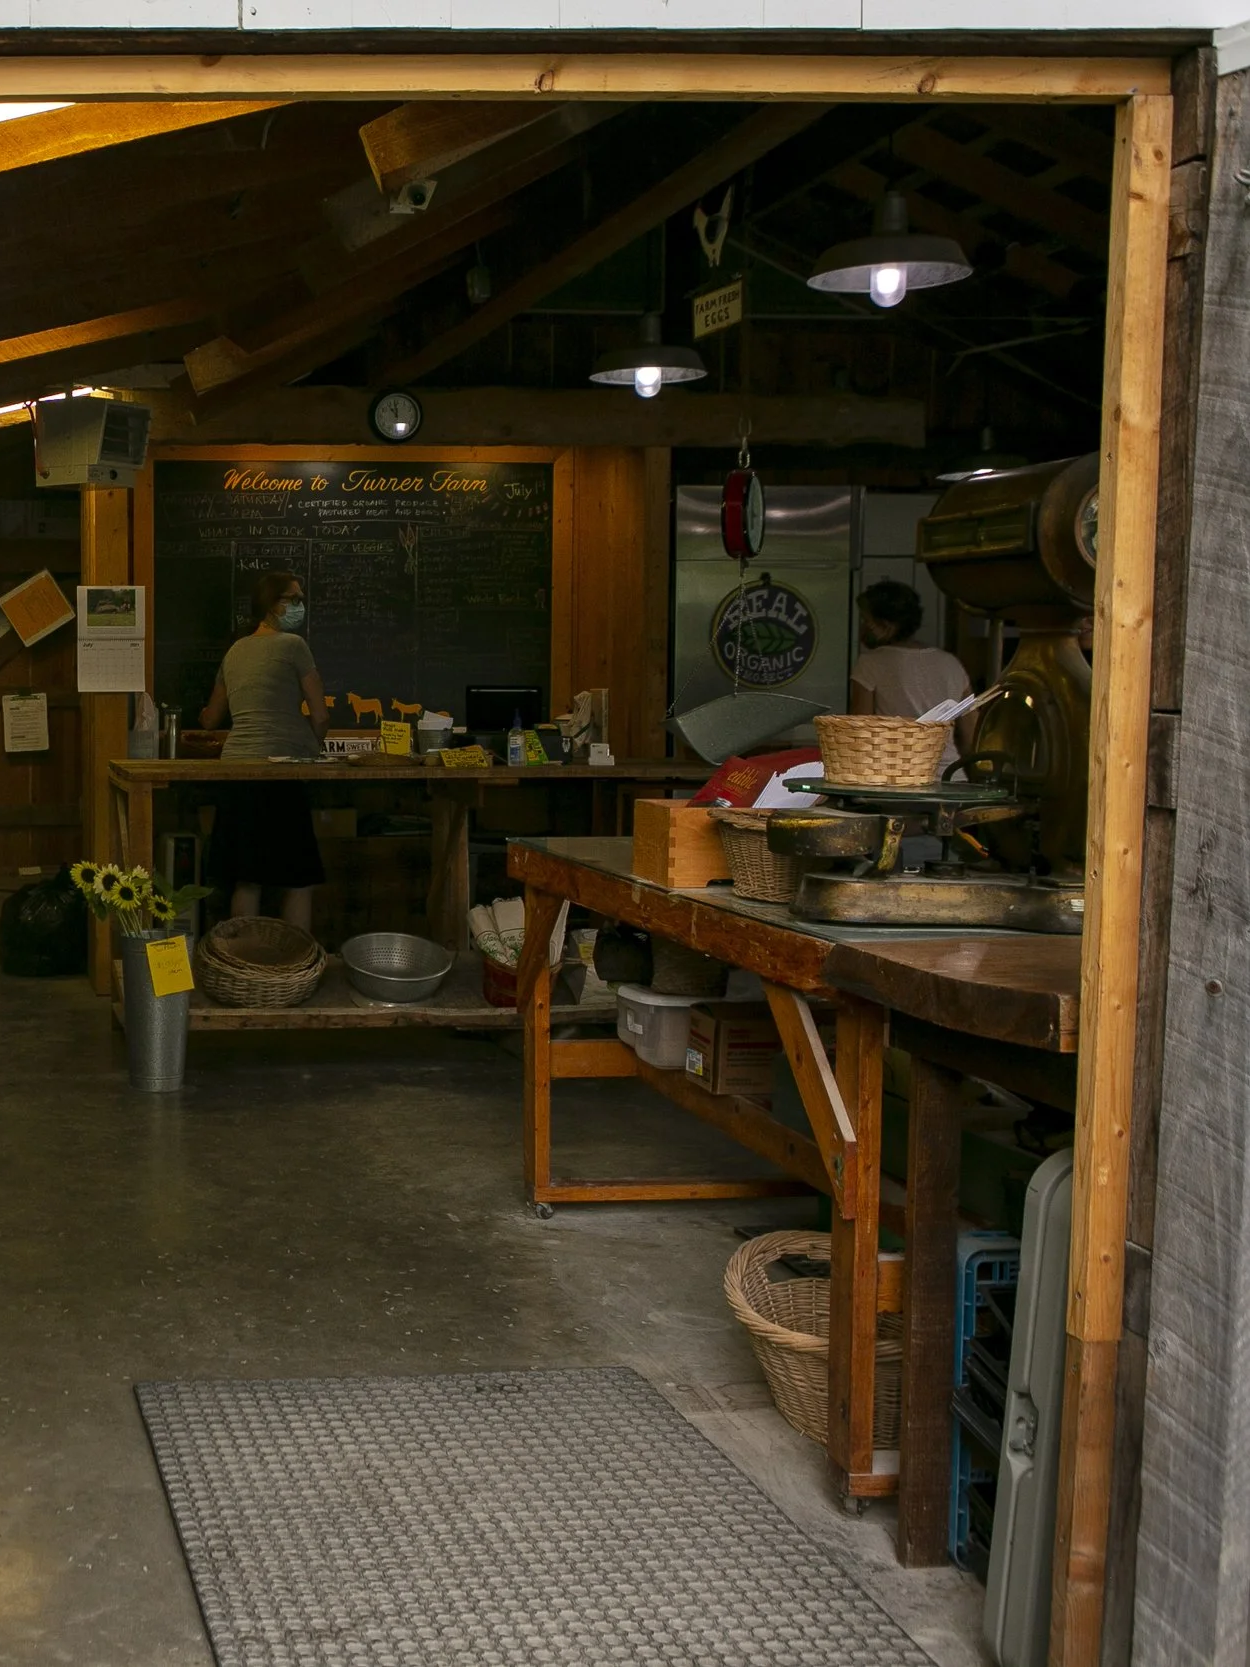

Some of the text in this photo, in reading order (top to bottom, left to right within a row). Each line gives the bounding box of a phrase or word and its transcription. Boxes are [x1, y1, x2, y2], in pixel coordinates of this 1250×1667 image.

[696, 290, 740, 315] FARM FRESH
[704, 307, 730, 328] EGGS
[222, 468, 489, 494] Welcome to Turner Farm
[503, 482, 533, 500] July
[297, 499, 439, 509] CERTIFIED ORGANIC PRODUCE
[318, 508, 361, 517] PASTURED
[365, 508, 390, 517] MEAT
[394, 508, 413, 517] AND
[249, 525, 263, 537] IN
[267, 525, 305, 537] STOCK
[312, 524, 361, 537] TODAY
[239, 558, 271, 572] Kale
[726, 588, 808, 635] REAL
[723, 641, 804, 672] ORGANIC
[320, 741, 346, 753] ARM
